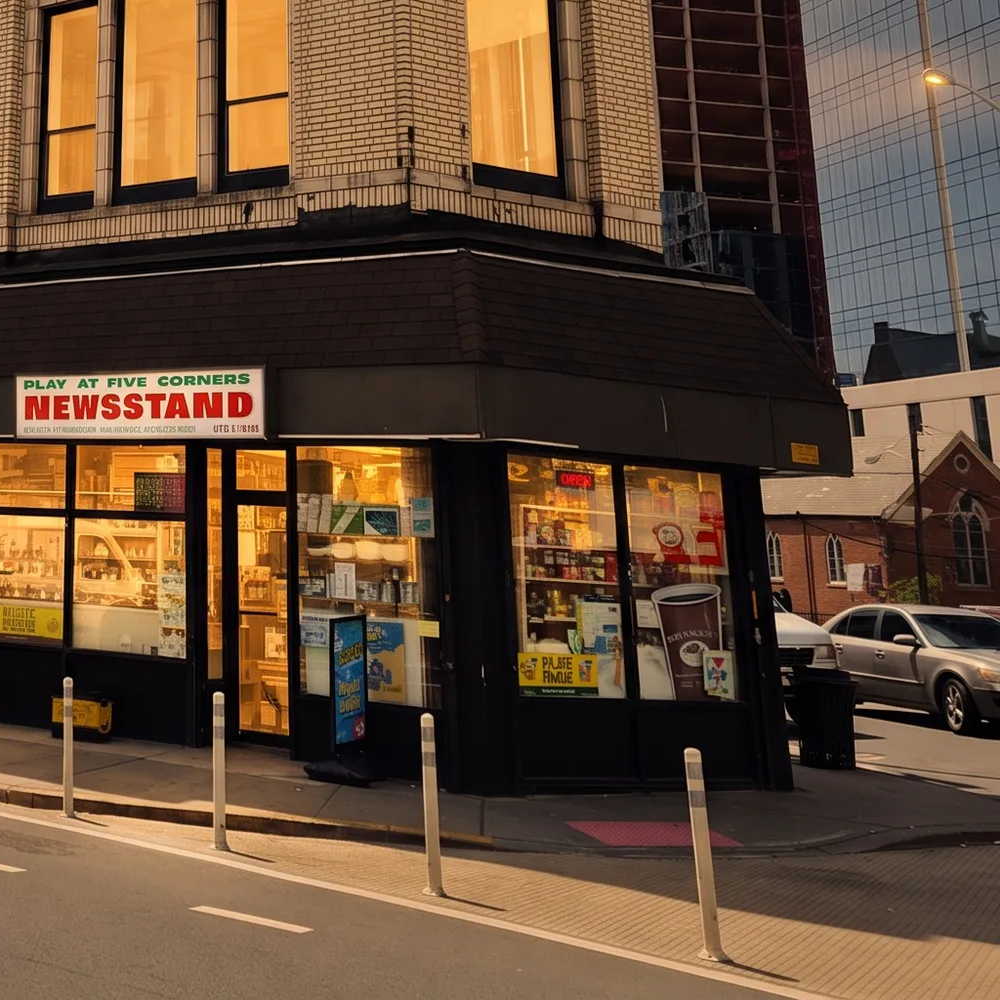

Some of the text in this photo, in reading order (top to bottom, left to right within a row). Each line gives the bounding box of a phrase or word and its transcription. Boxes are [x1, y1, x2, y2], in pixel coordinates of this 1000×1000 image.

[23, 373, 251, 390] PLAY AT FIVE CORNERS
[24, 391, 254, 421] NEWSSTAND
